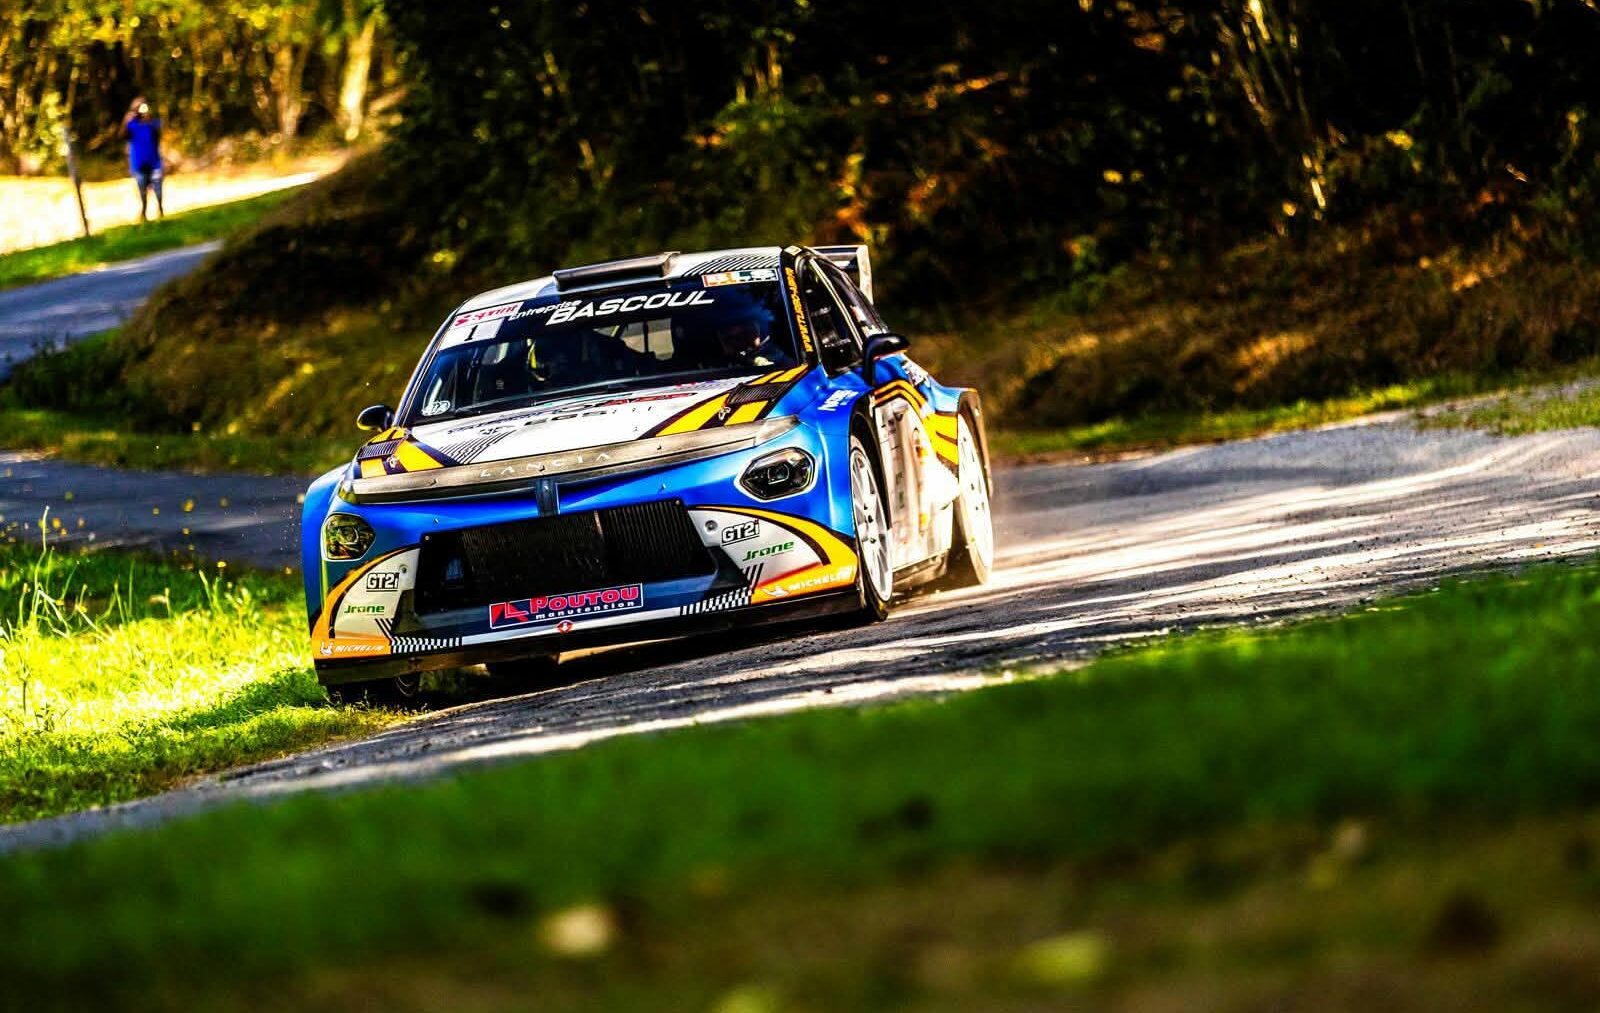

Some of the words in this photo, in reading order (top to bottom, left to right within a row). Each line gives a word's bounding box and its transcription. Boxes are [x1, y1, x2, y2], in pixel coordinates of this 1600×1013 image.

[546, 291, 714, 326] BASCOUL
[464, 324, 478, 341] 1
[479, 451, 611, 478] LANCIA
[722, 518, 760, 543] GT2i
[366, 572, 399, 589] GT2i
[788, 566, 851, 590] MICHEL
[535, 600, 635, 620] manutention
